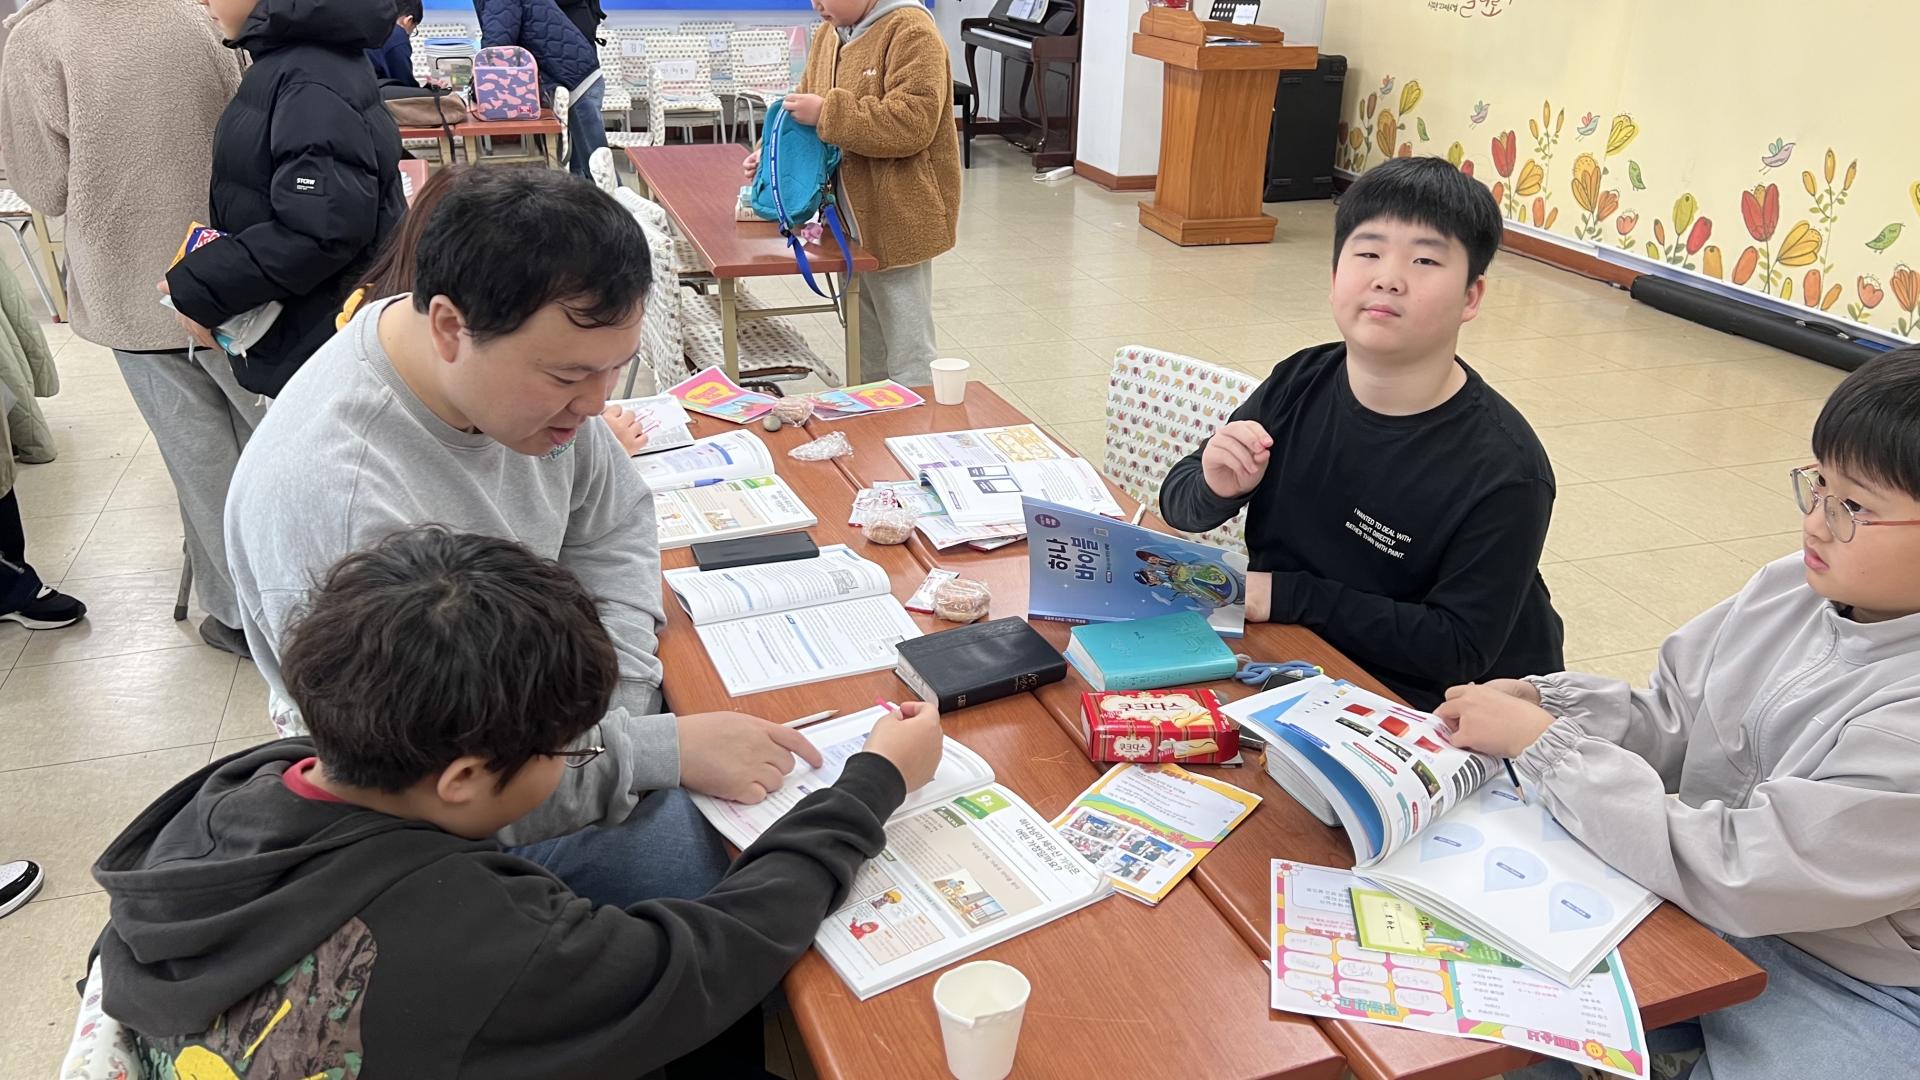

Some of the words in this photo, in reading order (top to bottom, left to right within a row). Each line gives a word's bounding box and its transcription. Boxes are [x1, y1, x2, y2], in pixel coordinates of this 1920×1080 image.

[1345, 521, 1363, 536] RATHER
[1363, 532, 1375, 545] THAN
[1374, 541, 1388, 553] WITH
[1387, 548, 1405, 559] PAINT.
[1357, 509, 1375, 526] WANTED
[1375, 521, 1382, 530] TO
[1382, 525, 1396, 537] DEAL
[1396, 532, 1412, 543] WITH
[1359, 521, 1373, 533] LIGHT
[1372, 530, 1396, 546] DIRECTLY
[1046, 538, 1071, 571] 하나
[1071, 536, 1101, 581] 바이블
[1118, 702, 1184, 712] 쿠크다스
[1119, 742, 1147, 751] 쿠크다스
[1016, 828, 1030, 840] 어떤
[1028, 840, 1063, 872] 가정일까요?
[1019, 818, 1045, 840] 하나님이
[1042, 840, 1063, 858] 세우신
[1060, 857, 1080, 875] 가정은
